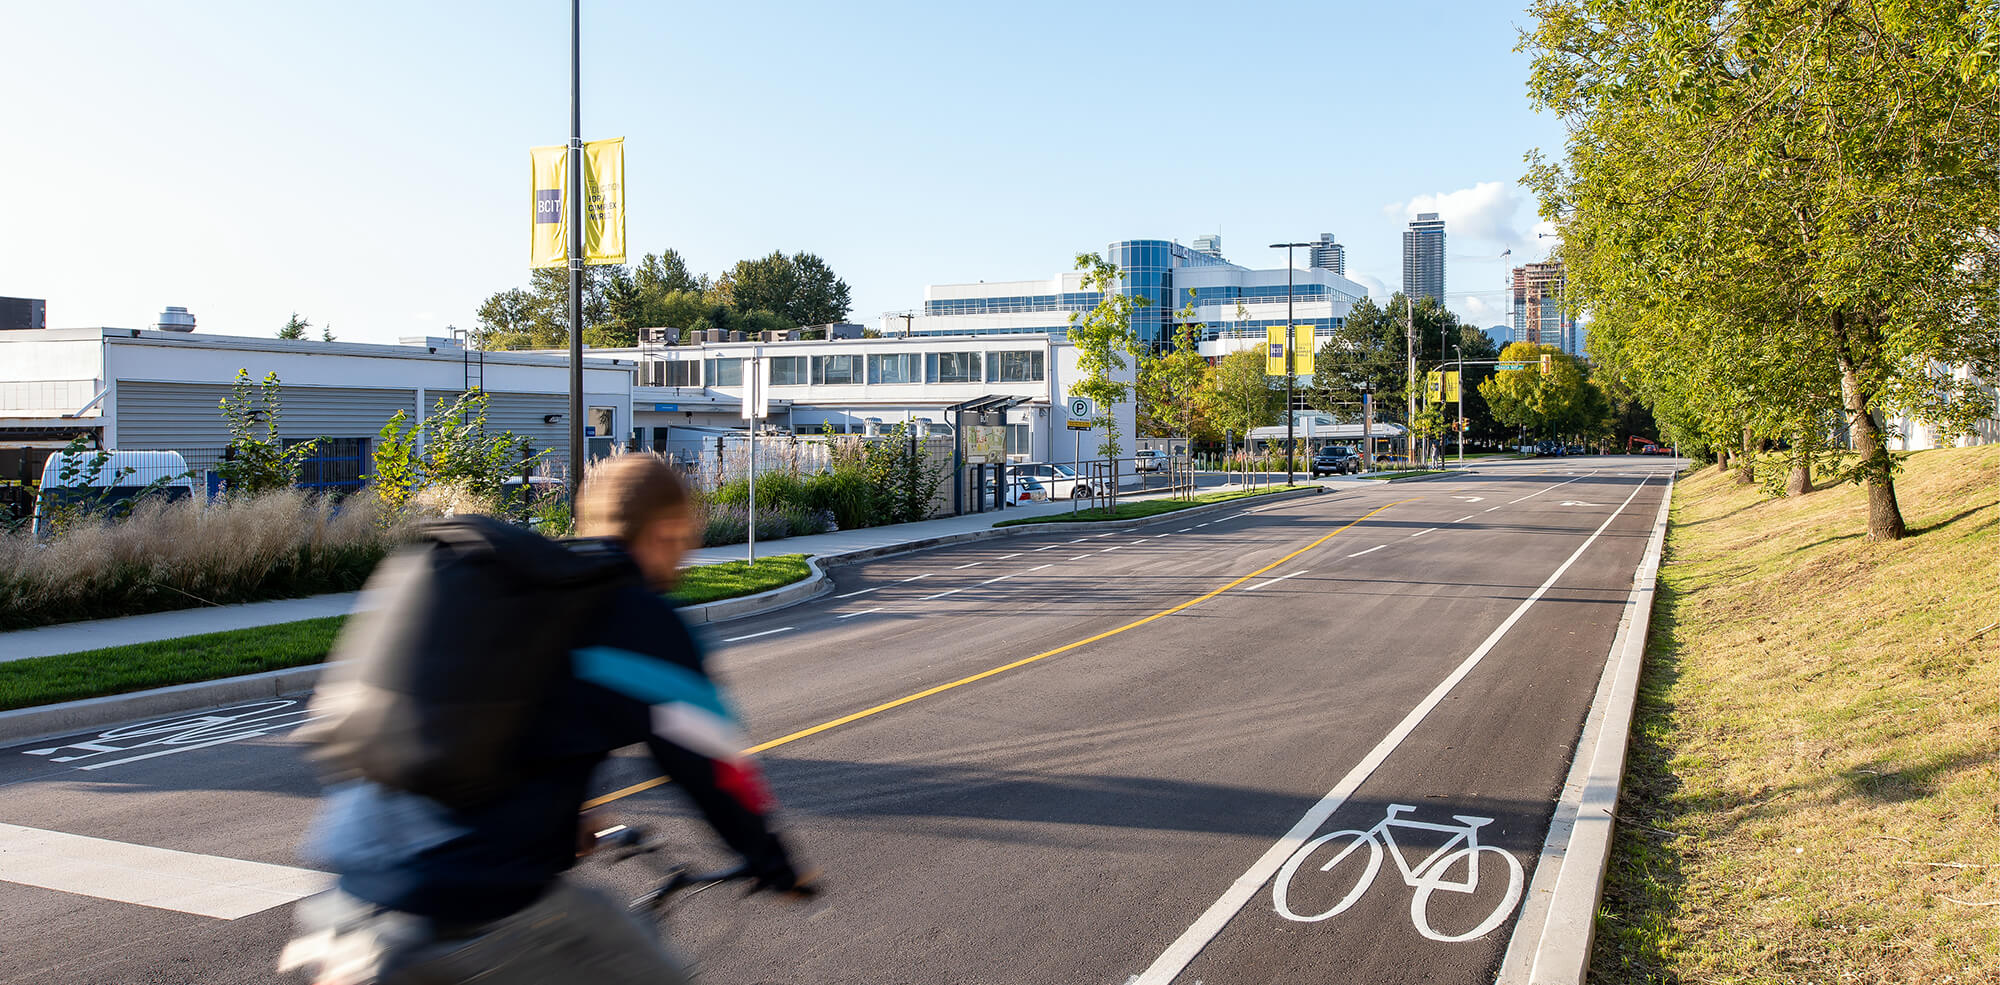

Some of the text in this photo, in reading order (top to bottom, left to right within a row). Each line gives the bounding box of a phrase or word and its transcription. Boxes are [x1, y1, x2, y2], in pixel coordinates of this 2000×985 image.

[538, 199, 560, 212] BCIT
[589, 212, 612, 221] WRL
[1076, 403, 1084, 413] P
